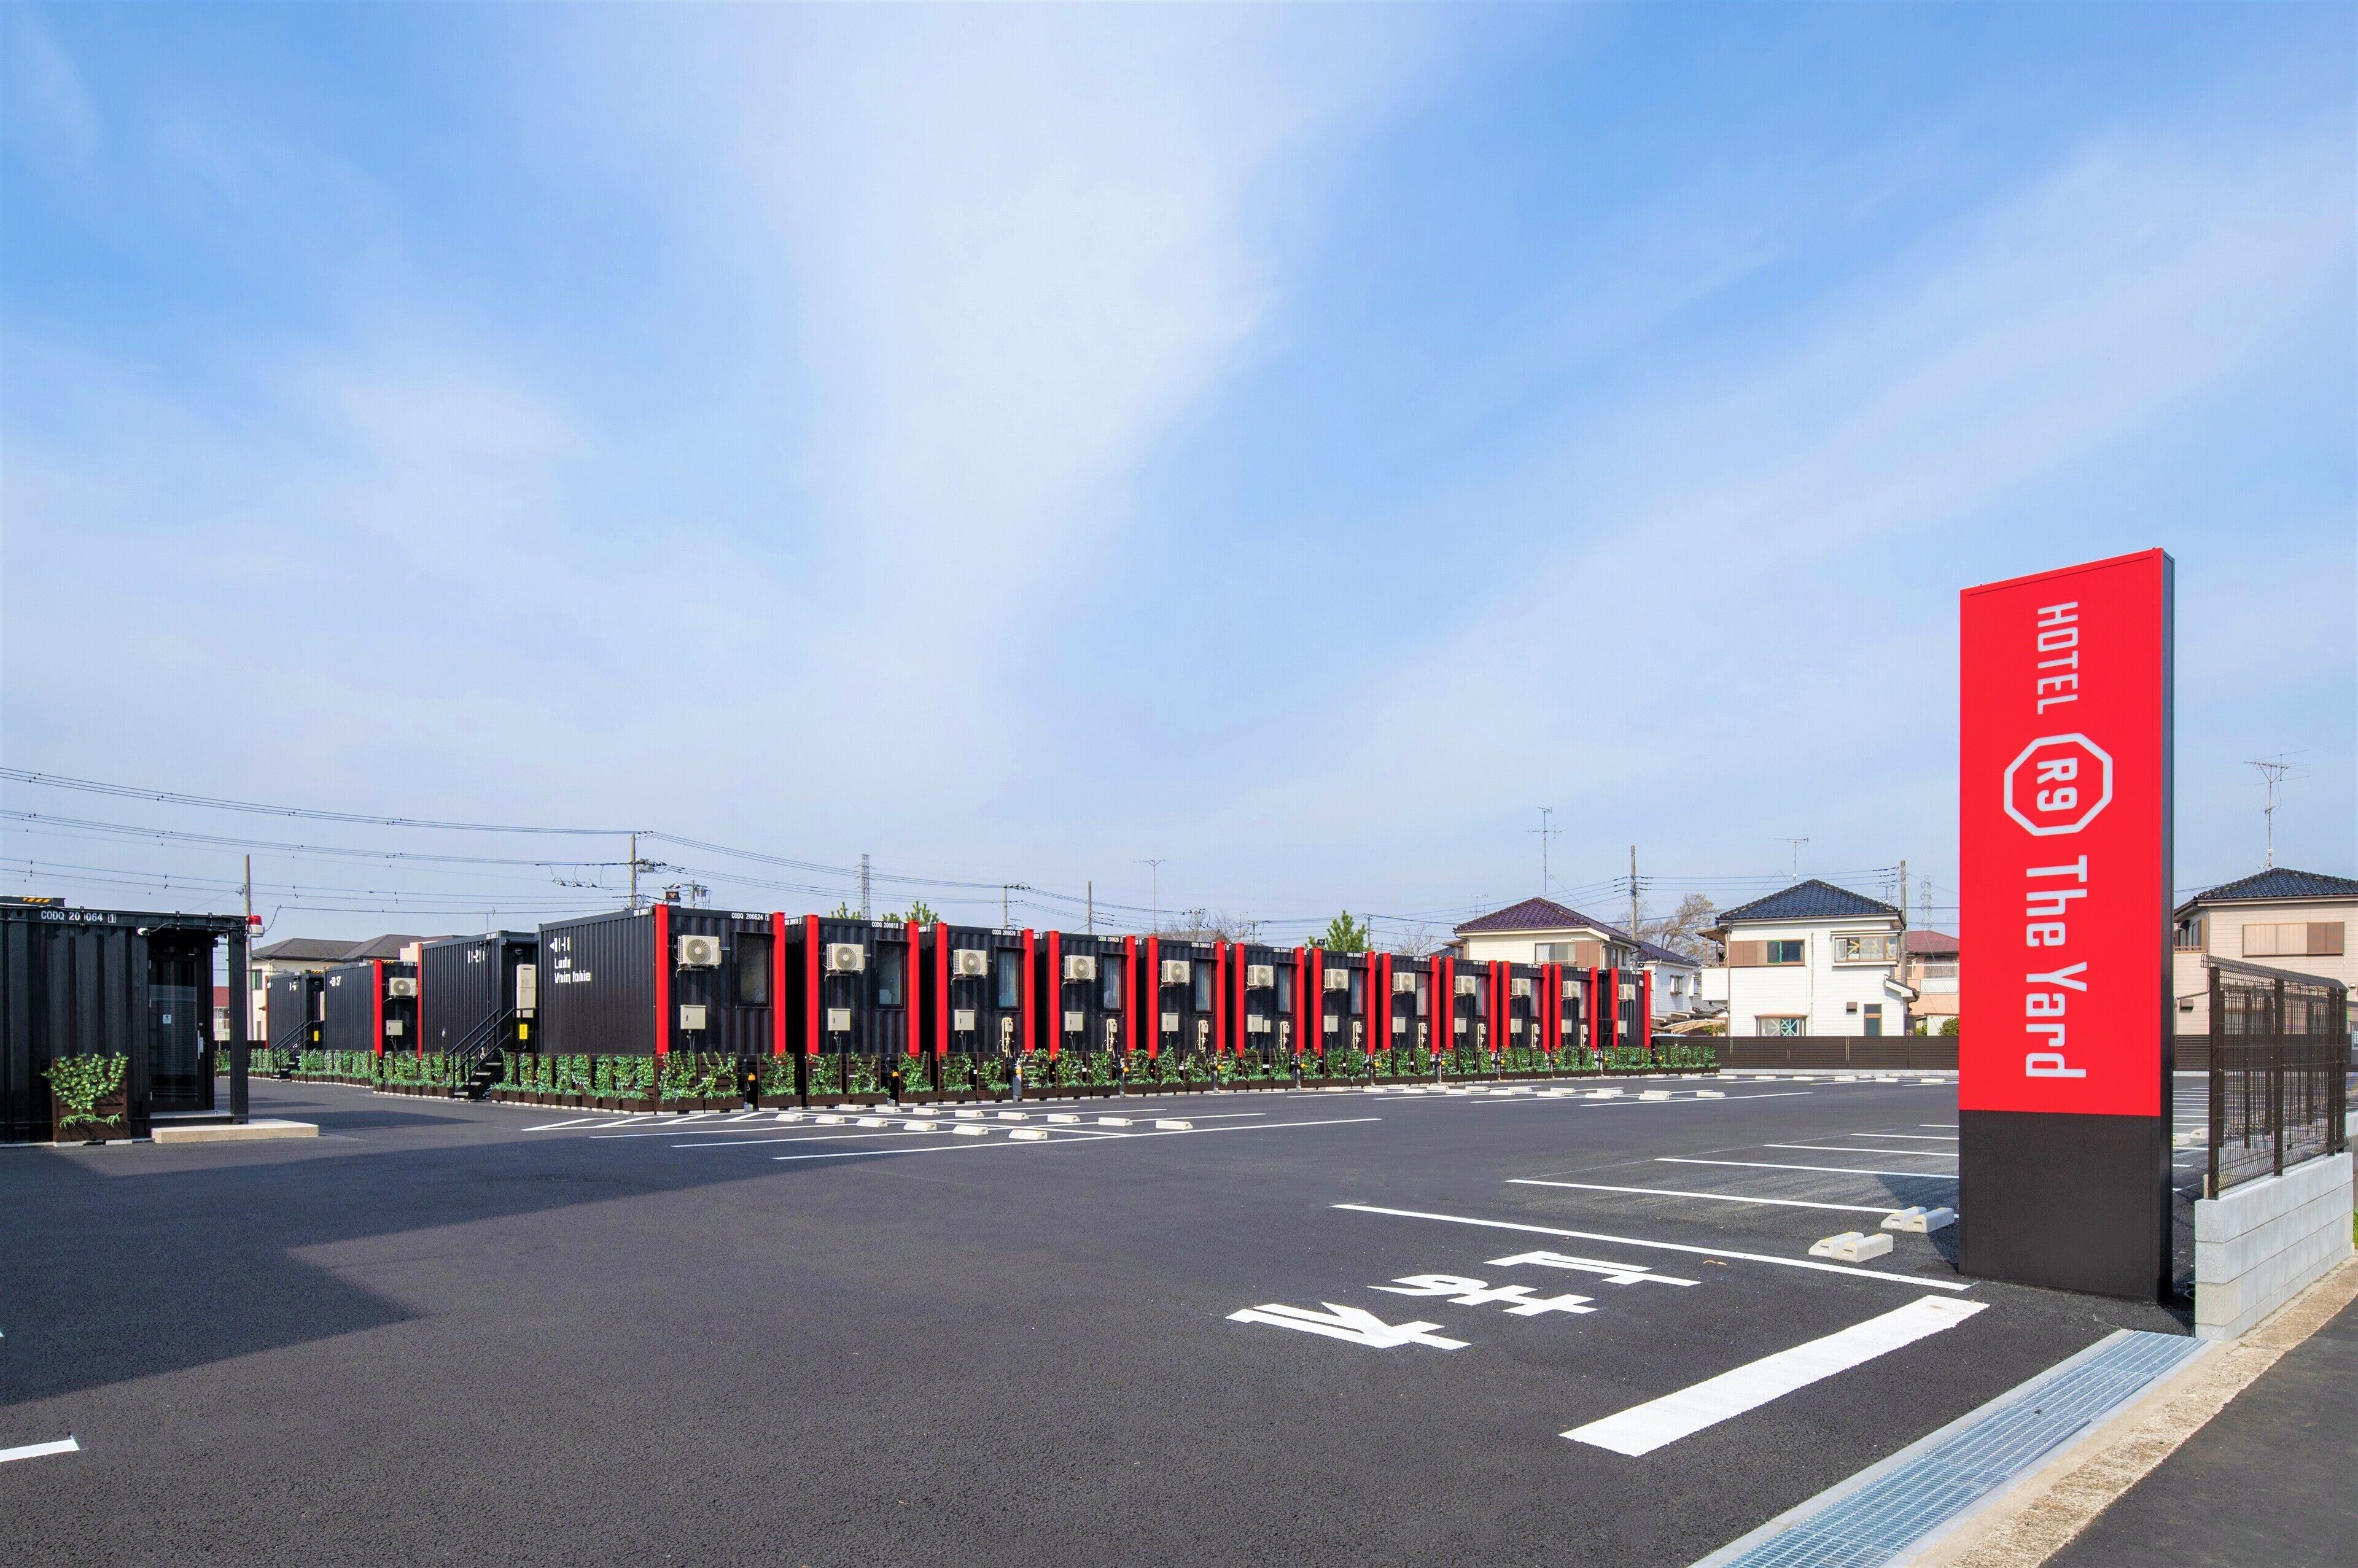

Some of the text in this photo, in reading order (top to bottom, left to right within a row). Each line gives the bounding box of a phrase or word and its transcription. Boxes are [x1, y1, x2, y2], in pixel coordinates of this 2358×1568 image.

[2025, 601, 2087, 1078] HOTEL R9 The Yard
[41, 910, 116, 923] CODQ 20064 1
[1226, 1251, 1702, 1350] 止まれ
